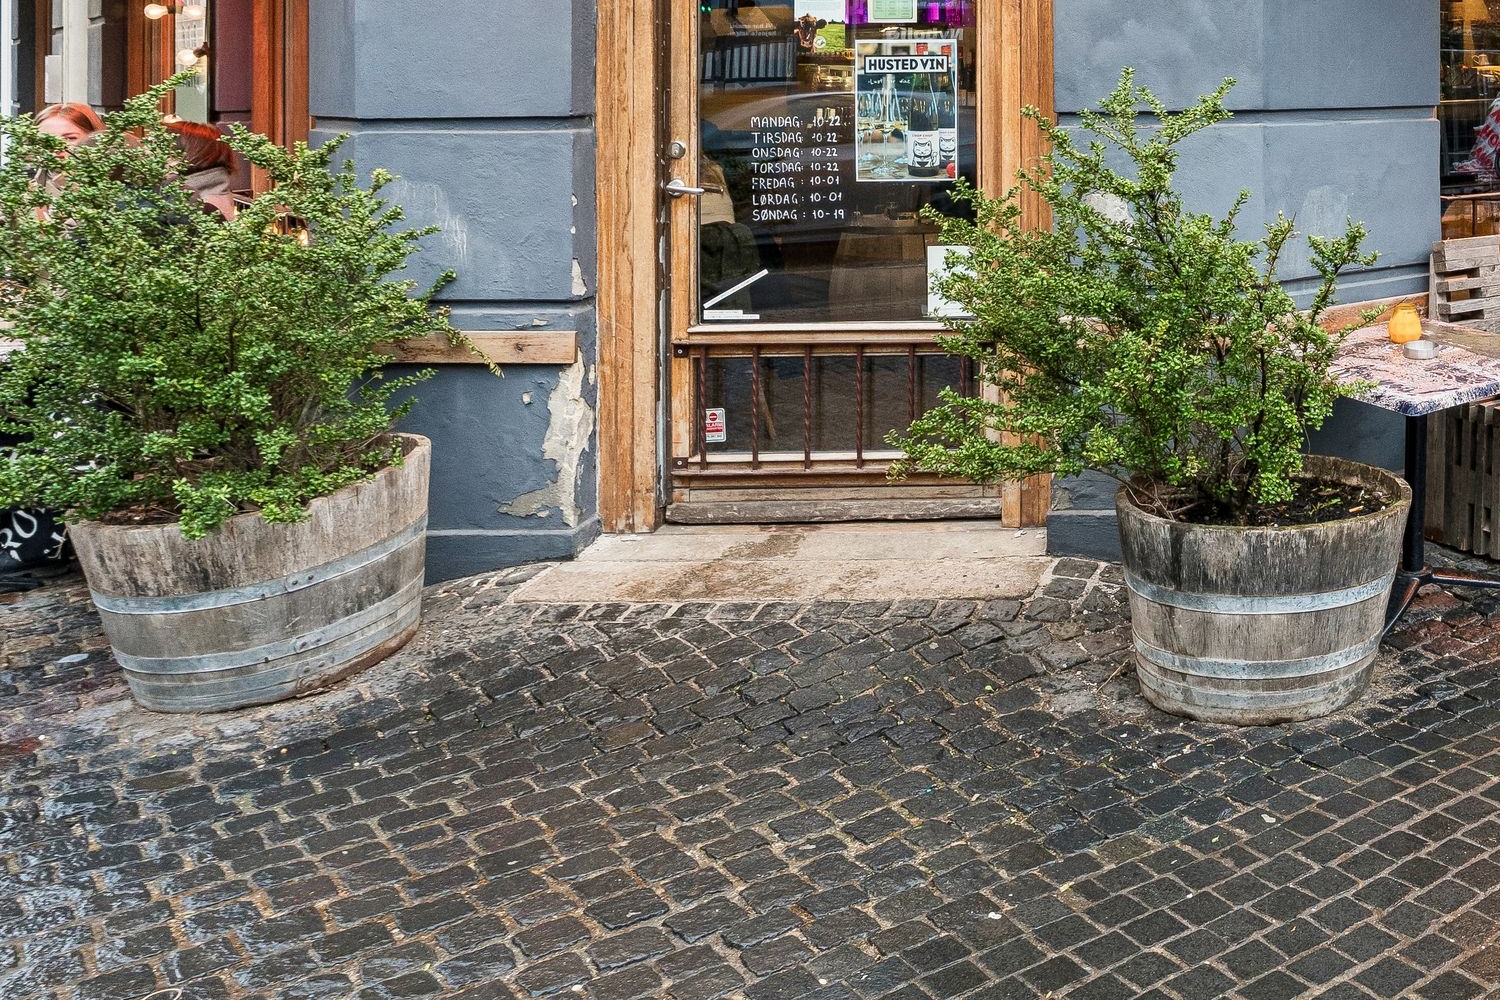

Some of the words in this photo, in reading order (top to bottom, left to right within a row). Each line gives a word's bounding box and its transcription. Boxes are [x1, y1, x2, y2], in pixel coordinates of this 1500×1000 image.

[868, 58, 918, 70] HUSTED
[918, 58, 944, 70] VIN
[813, 116, 840, 127] 10-22
[811, 147, 838, 157] 10-22
[810, 162, 839, 171] 10-22
[810, 176, 839, 186] 10-01
[810, 192, 842, 202] 10-01
[812, 209, 844, 219] 10-19
